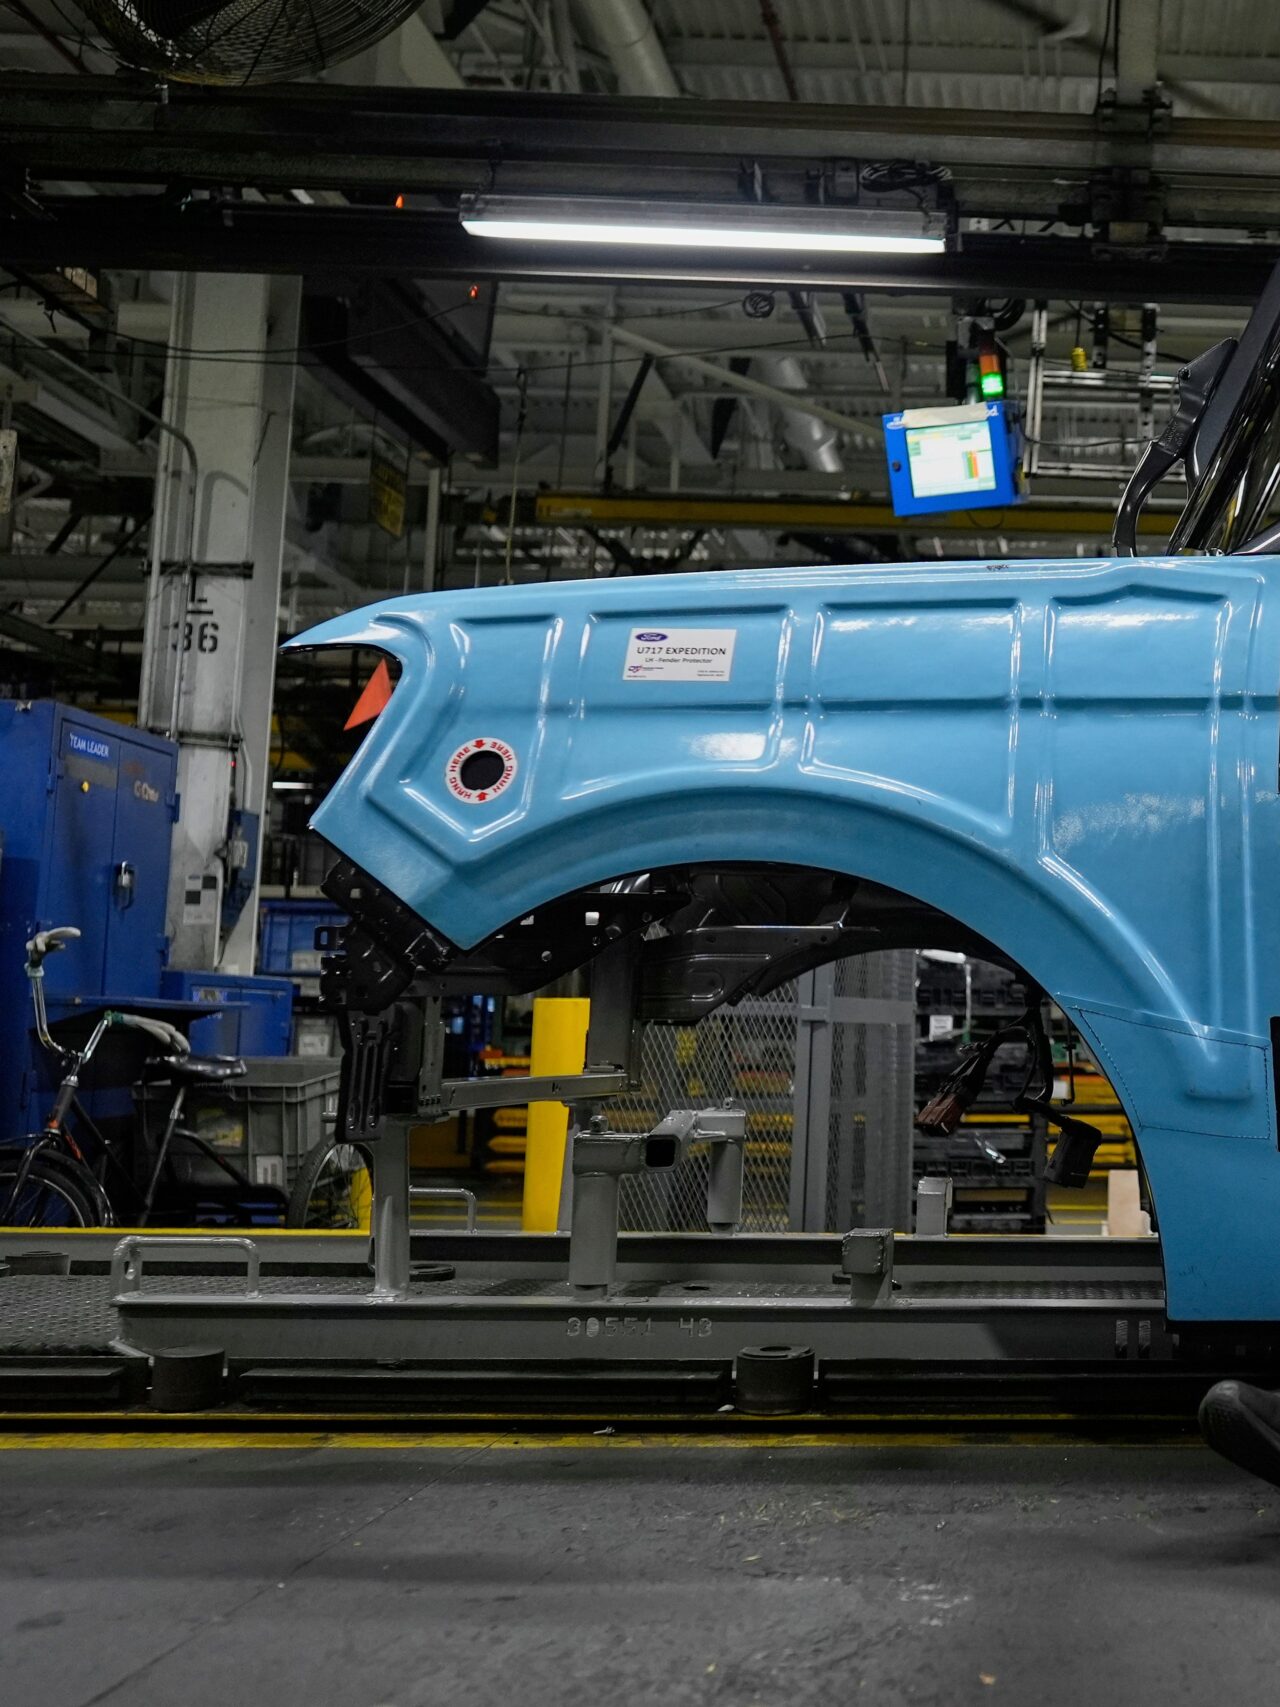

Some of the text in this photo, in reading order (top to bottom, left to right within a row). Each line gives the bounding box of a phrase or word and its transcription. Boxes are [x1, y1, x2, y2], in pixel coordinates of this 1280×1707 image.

[637, 646, 727, 655] U717 EXPEDITION
[69, 733, 109, 758] TEAM LEADER
[449, 747, 472, 799] HANG HERE
[490, 741, 513, 793] HANG HERE
[679, 1317, 712, 1338] 43
